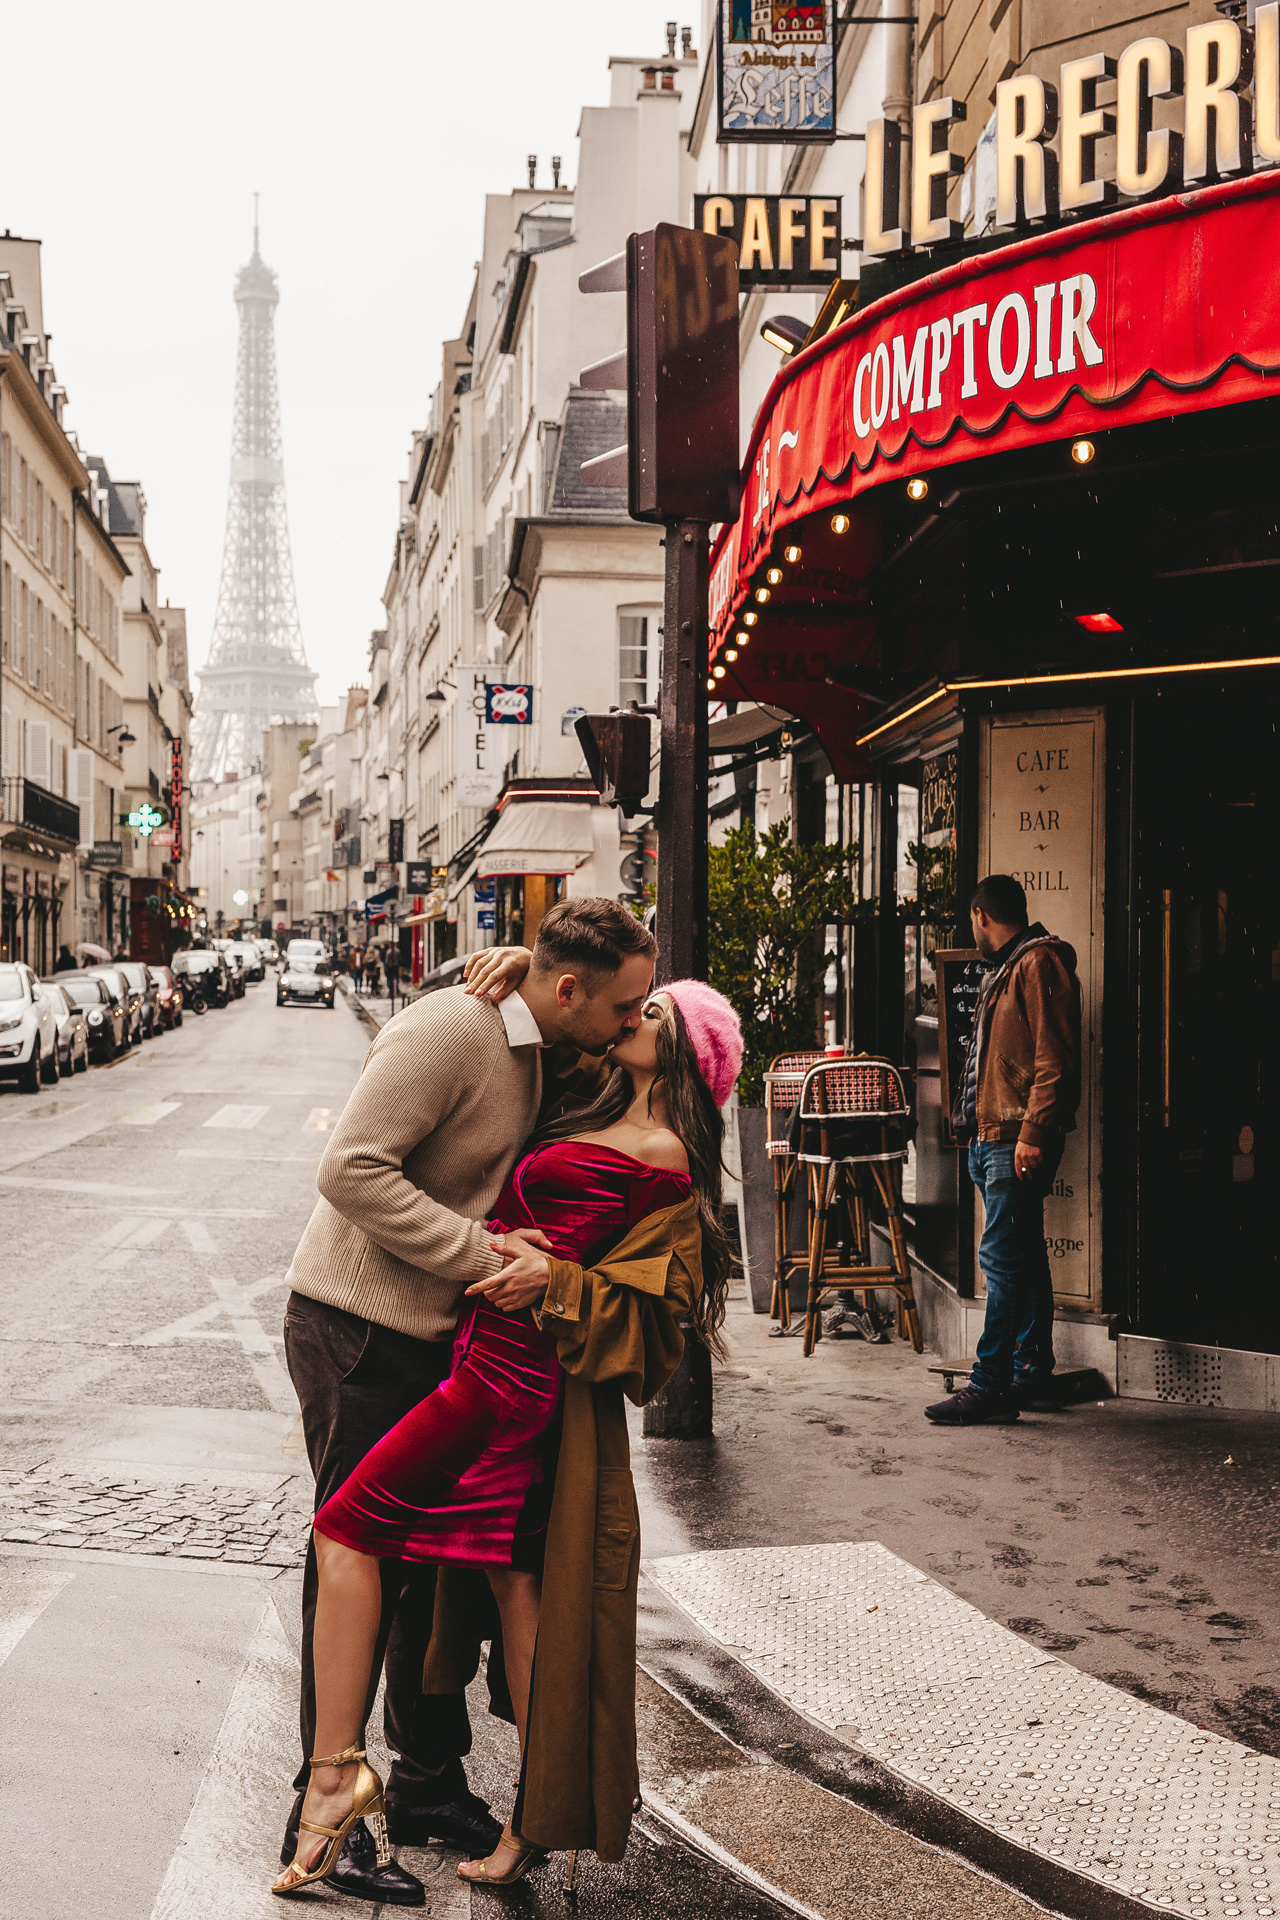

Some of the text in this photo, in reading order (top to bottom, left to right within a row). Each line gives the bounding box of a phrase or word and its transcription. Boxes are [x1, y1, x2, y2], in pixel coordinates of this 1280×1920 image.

[740, 50, 817, 70] Abbaye de
[726, 69, 833, 126] Leffe
[862, 96, 965, 258] LE
[852, 272, 1104, 439] COMPTOIR
[473, 674, 487, 770] HOTEL
[1016, 748, 1070, 773] CAFE
[172, 739, 182, 860] THOUMIEUX
[1018, 810, 1061, 832] BAR
[1045, 1237, 1084, 1258] agne
